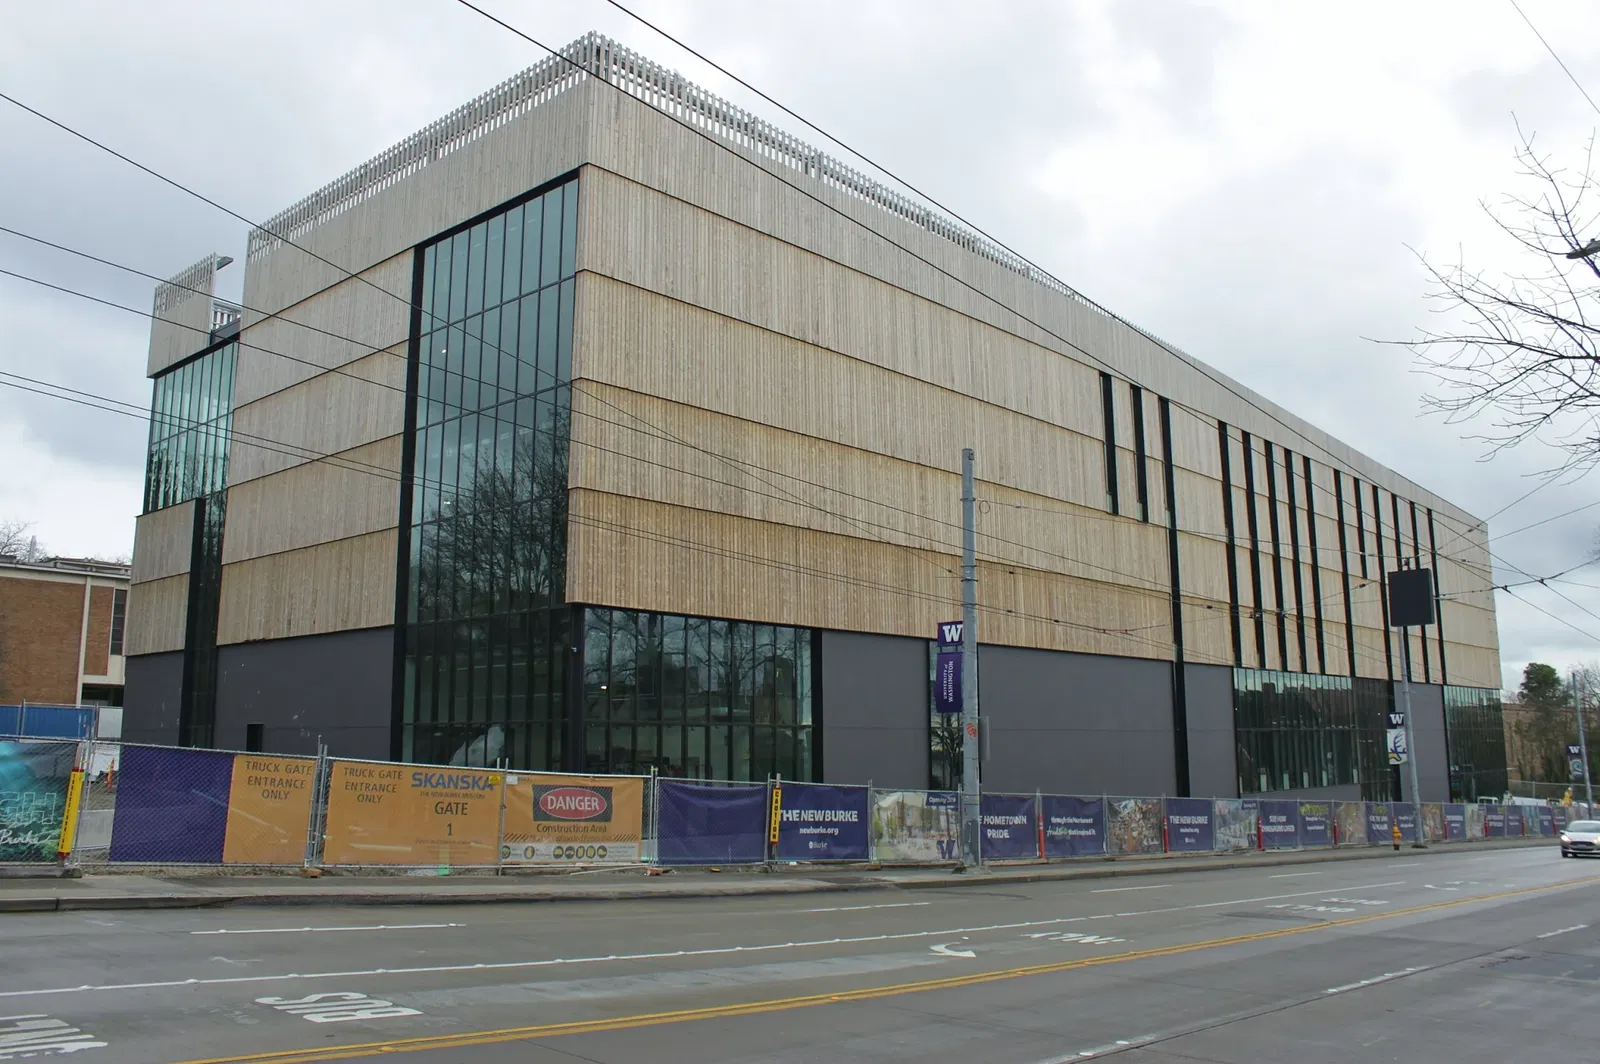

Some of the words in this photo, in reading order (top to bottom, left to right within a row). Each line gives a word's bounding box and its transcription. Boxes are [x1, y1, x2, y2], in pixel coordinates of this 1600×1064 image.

[942, 624, 963, 643] W
[1389, 713, 1405, 725] W
[1568, 745, 1581, 754] W
[245, 760, 281, 774] TRUCK
[284, 763, 313, 777] GATE
[343, 767, 376, 779] TRUCK
[378, 769, 404, 780] GATE
[247, 775, 306, 789] ENTRANCE
[344, 781, 397, 793] ENTRANCE
[411, 771, 494, 791] SKANSKA
[261, 789, 290, 801] ONLY
[356, 793, 384, 804] ONLY
[434, 801, 468, 816] GATE
[547, 795, 600, 811] DANGER
[800, 809, 825, 822] NEW
[825, 810, 859, 822] BURKE
[983, 815, 1027, 825] HOMETOWN
[446, 823, 453, 836] 1
[536, 823, 589, 834] Construction
[590, 824, 607, 833] Area
[986, 828, 1010, 839] PRIDE
[254, 991, 424, 1024] BUS
